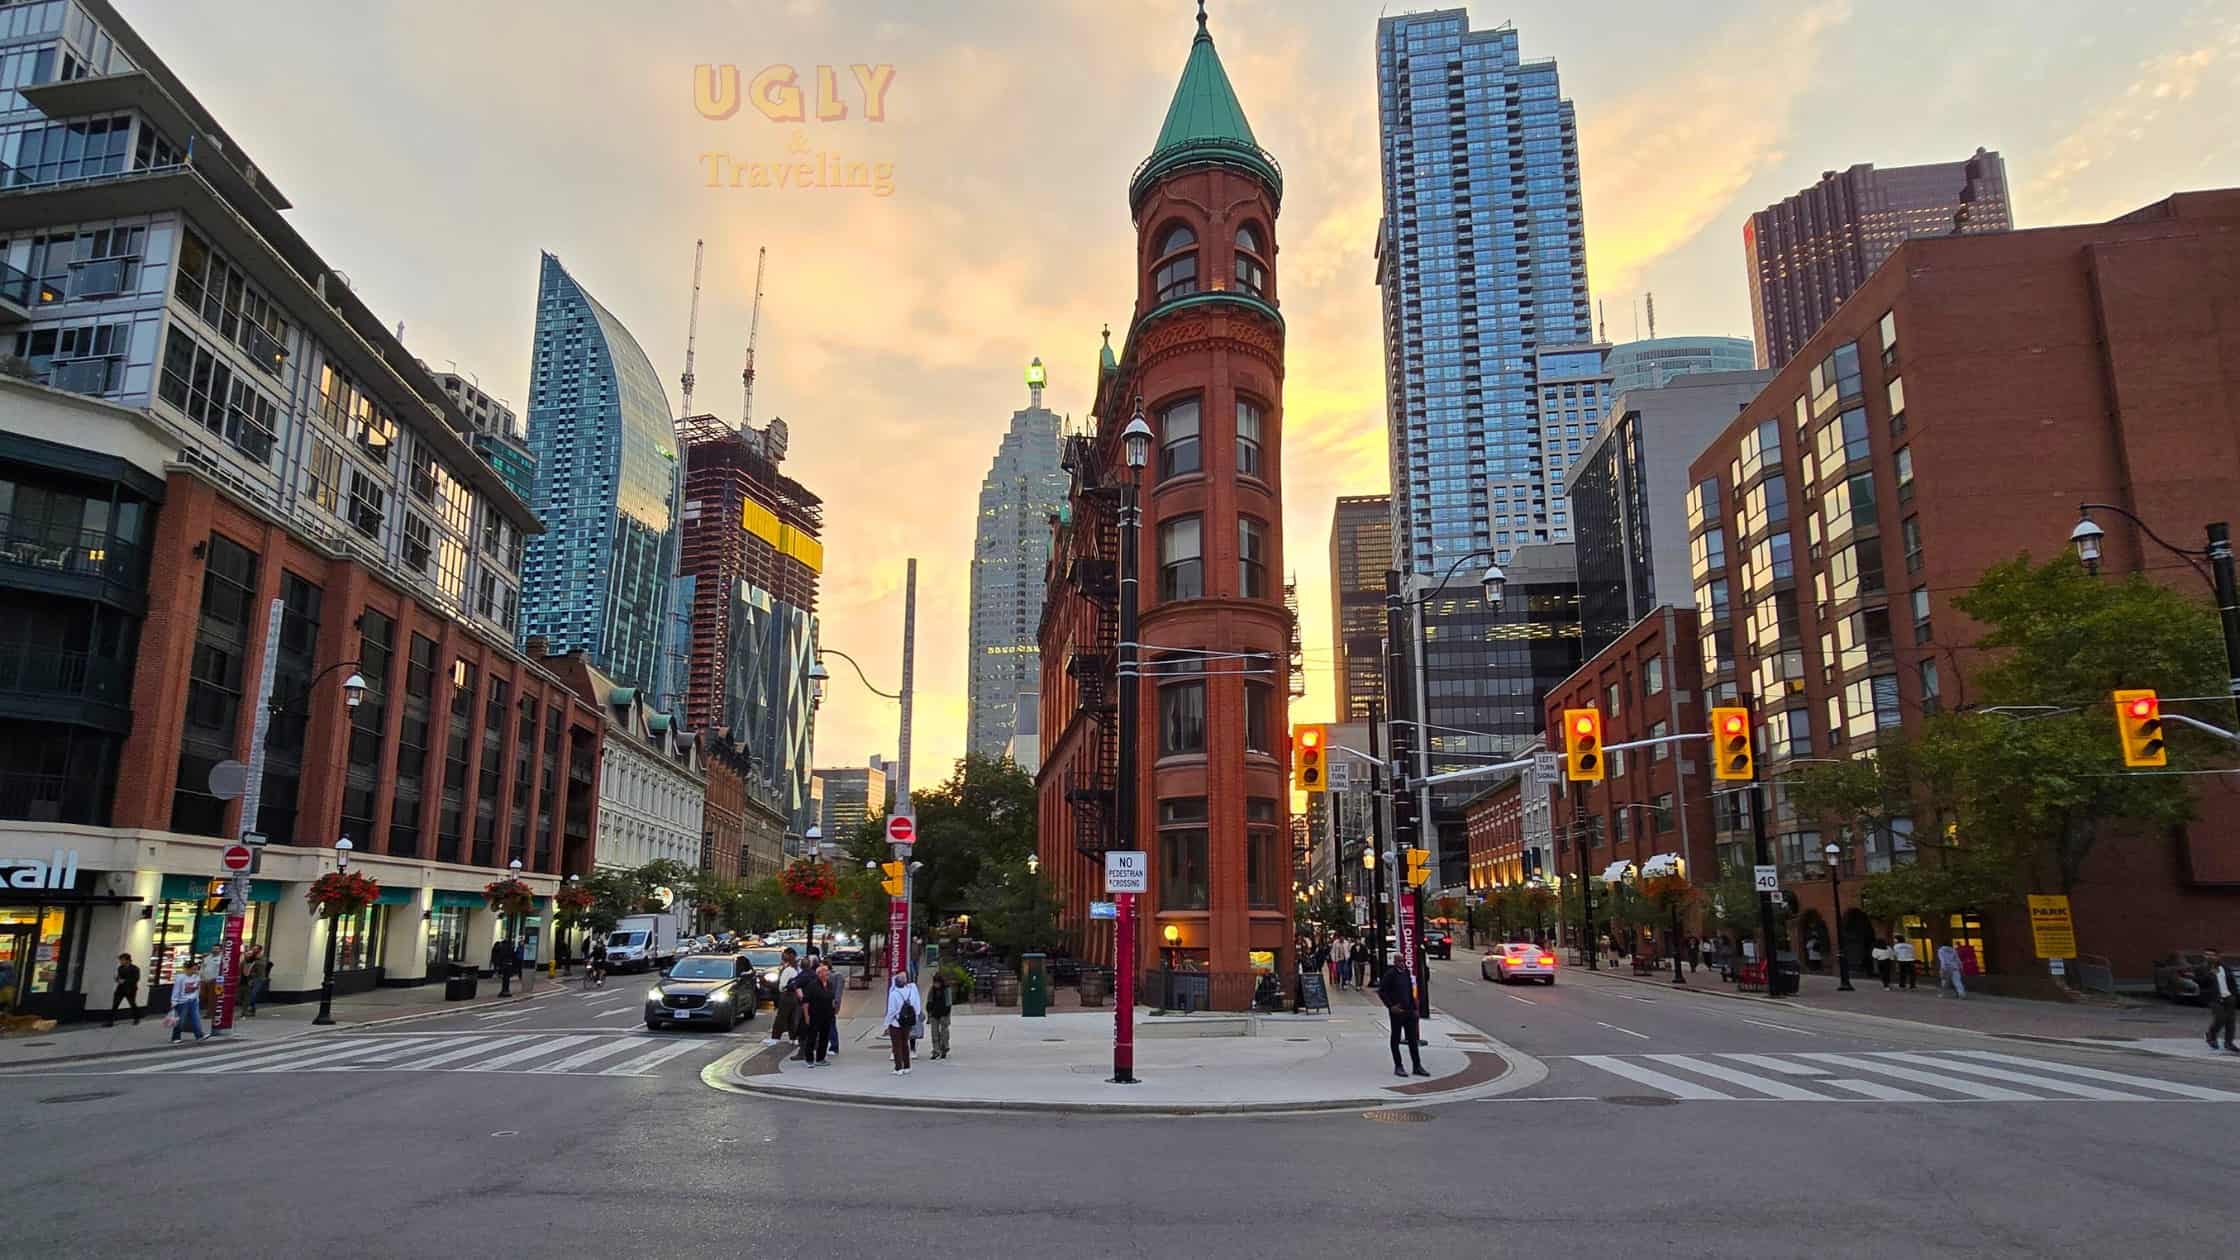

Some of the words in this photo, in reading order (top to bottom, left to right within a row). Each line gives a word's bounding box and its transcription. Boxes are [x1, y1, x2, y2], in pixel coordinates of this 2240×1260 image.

[1119, 857, 1133, 868] NO
[1757, 876, 1776, 888] 40
[222, 939, 233, 976] TORONTO
[891, 933, 900, 972] TORONTO
